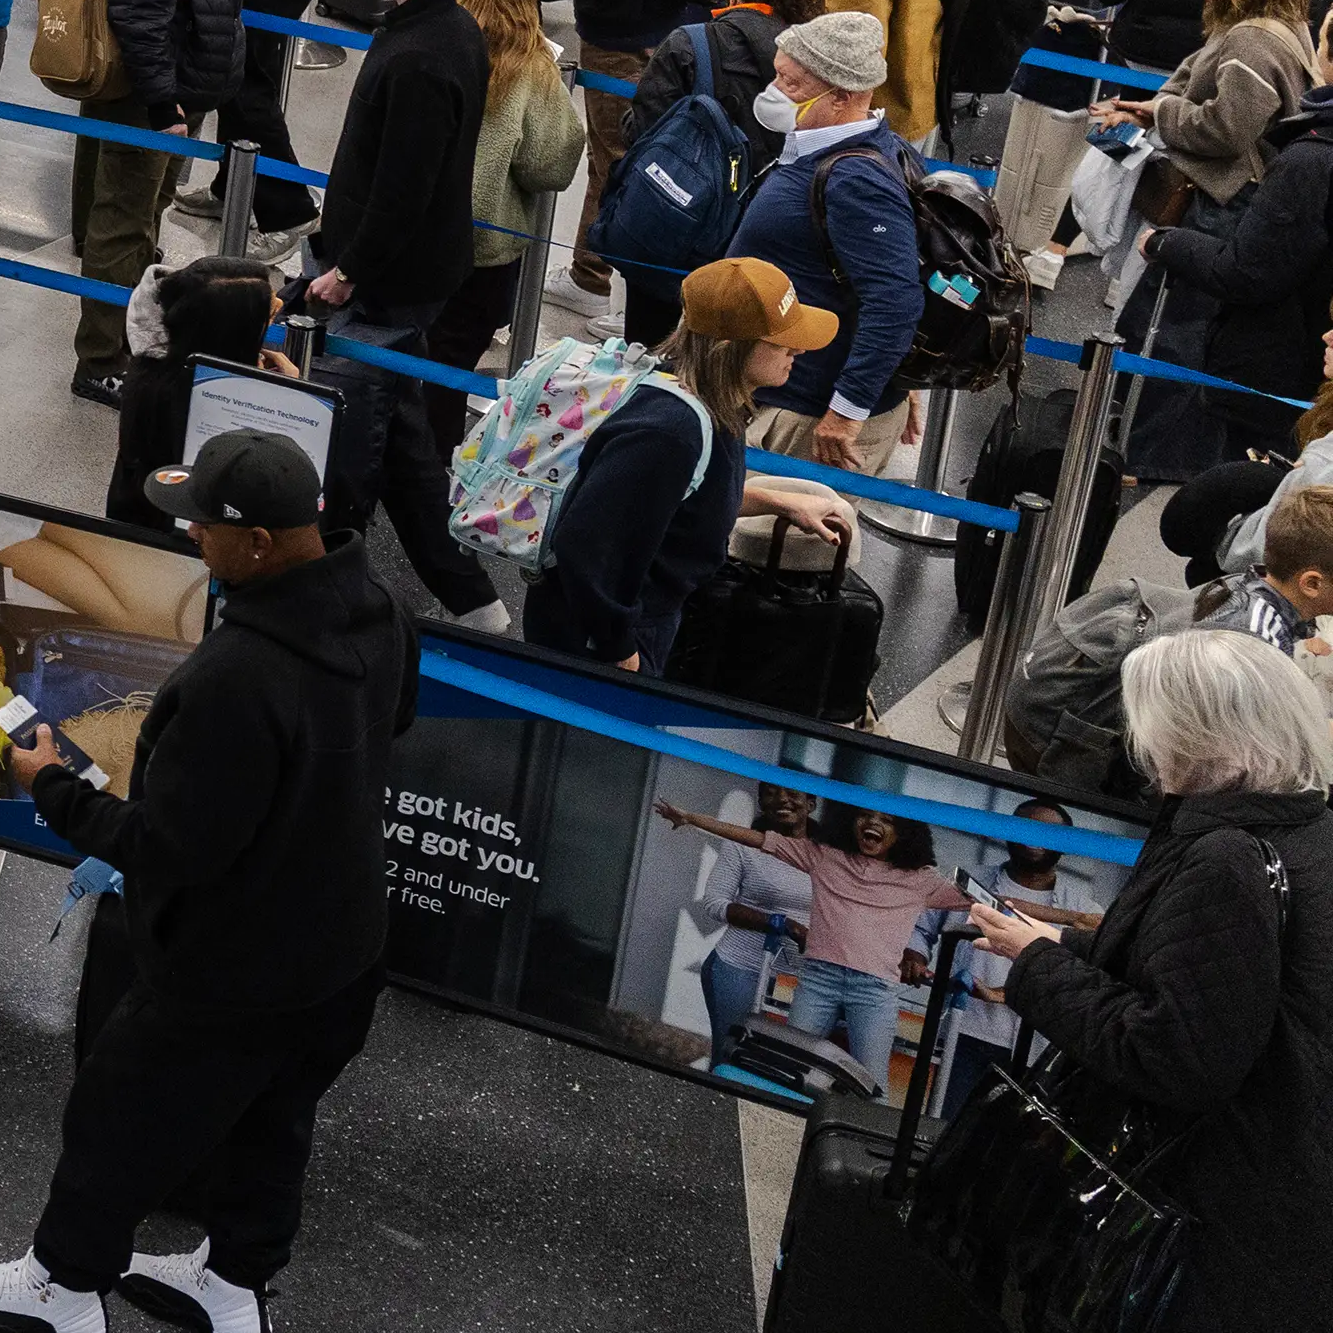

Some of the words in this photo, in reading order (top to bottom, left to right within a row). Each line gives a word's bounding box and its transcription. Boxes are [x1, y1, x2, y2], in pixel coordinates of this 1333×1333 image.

[42, 16, 68, 35] Taylor
[202, 390, 231, 404] Identity
[233, 398, 275, 415] Verification
[277, 410, 319, 428] Technology
[397, 790, 448, 821] got
[453, 801, 522, 847] kids,
[420, 831, 471, 861] got
[476, 846, 540, 884] you.
[401, 887, 446, 915] free.
[403, 867, 444, 890] and
[448, 880, 511, 909] under
